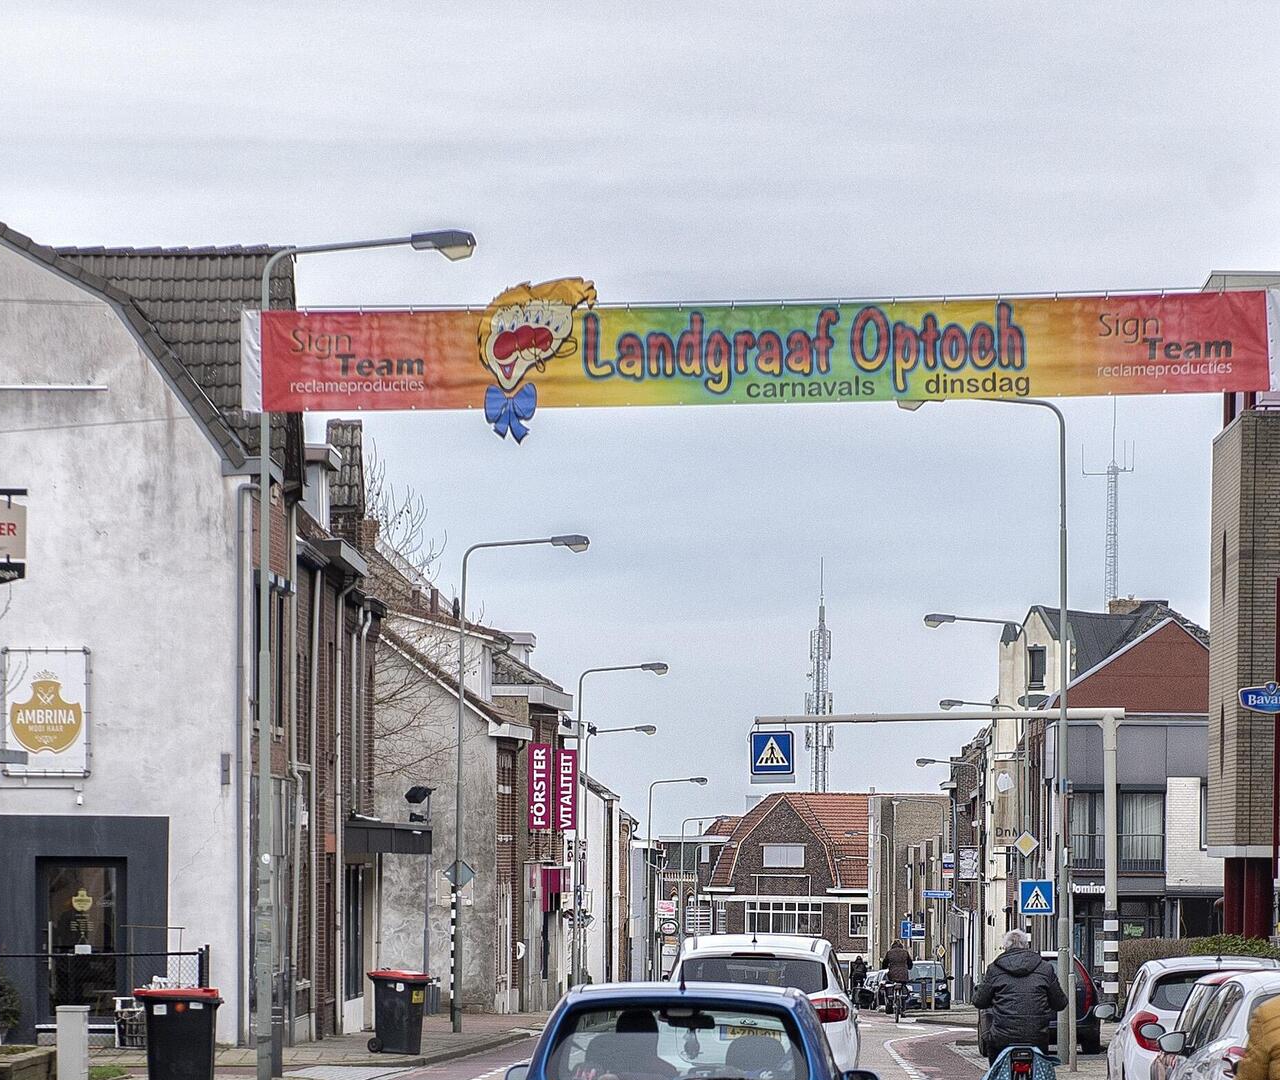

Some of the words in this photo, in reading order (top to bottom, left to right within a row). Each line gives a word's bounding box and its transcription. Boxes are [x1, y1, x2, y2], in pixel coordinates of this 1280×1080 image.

[1098, 312, 1160, 344] Sign
[290, 328, 352, 360] Sign
[581, 306, 841, 394] Landgraaf
[1142, 337, 1233, 361] Team
[336, 353, 424, 377] Team
[1097, 361, 1233, 379] reclameproducties
[290, 378, 424, 396] reclameproducties
[746, 375, 876, 399] carnavals
[924, 372, 1031, 397] dinsdag
[16, 709, 76, 725] AMBRINA
[530, 747, 546, 826] FÖRSTER
[560, 752, 573, 828] VITALITEIT
